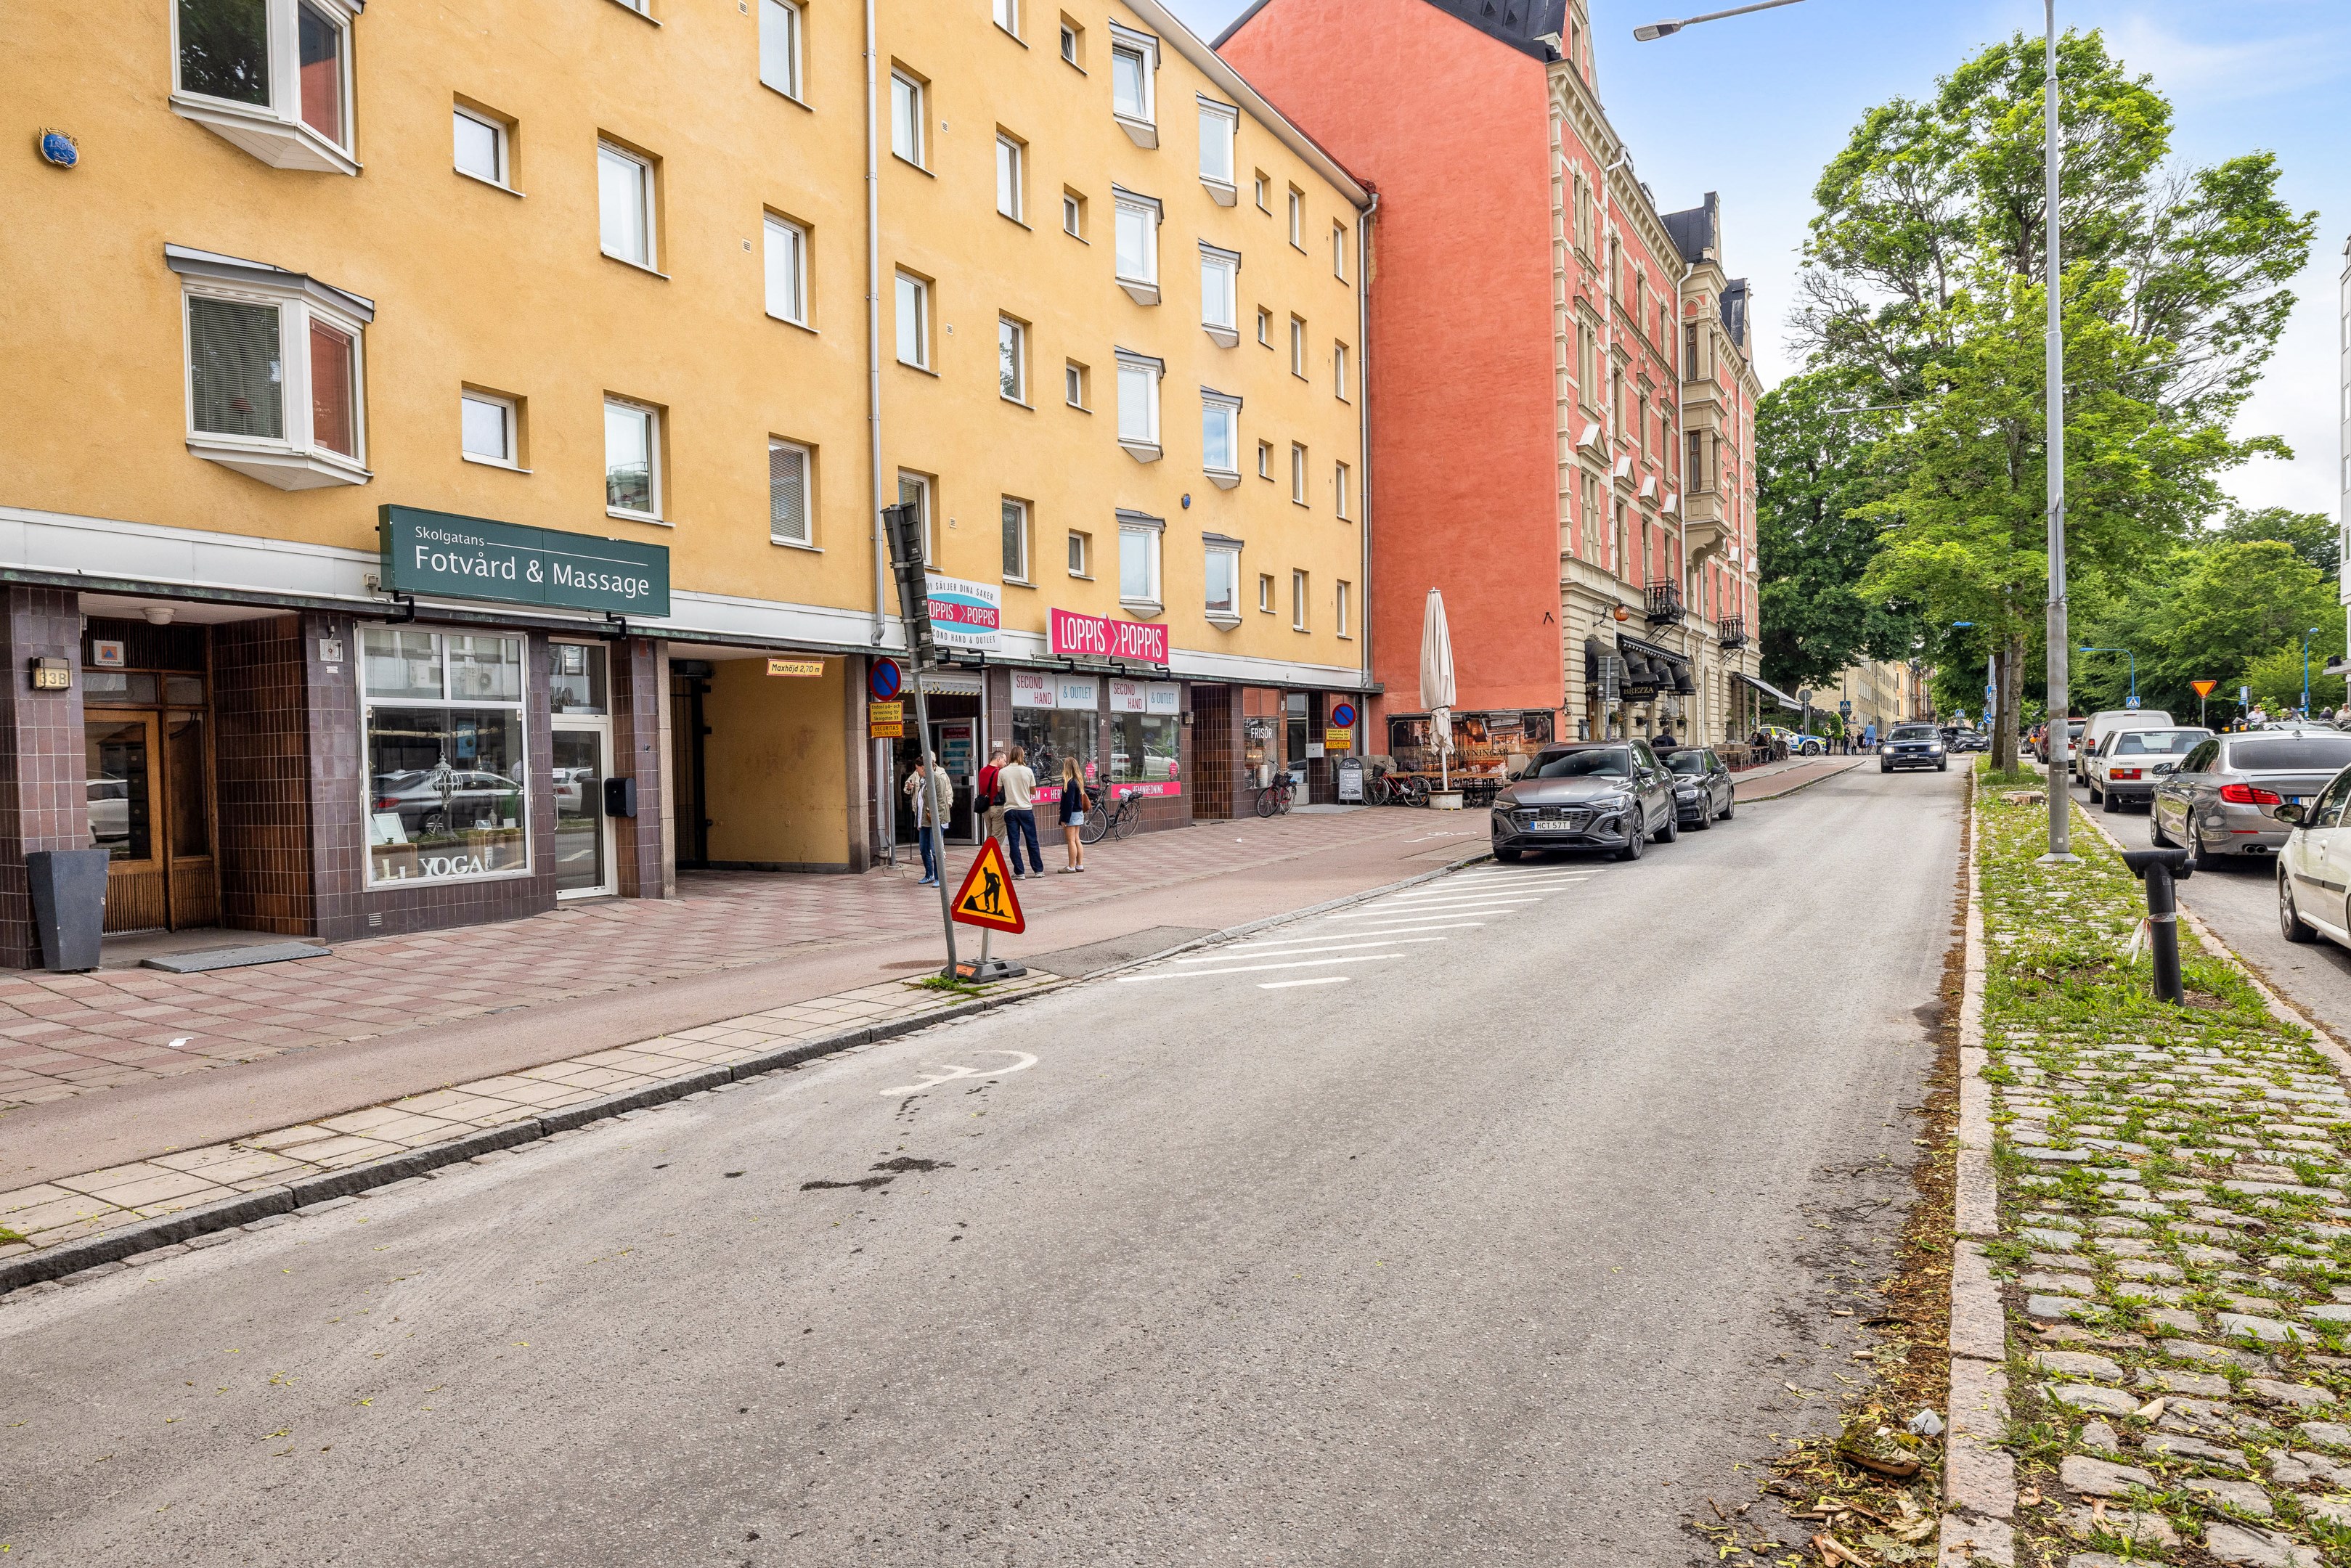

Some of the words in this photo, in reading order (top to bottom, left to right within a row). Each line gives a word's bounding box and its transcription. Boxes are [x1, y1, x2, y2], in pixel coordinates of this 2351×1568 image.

[415, 526, 484, 546] Skolgatans
[415, 545, 516, 580] Fotvård
[526, 560, 544, 583] &
[553, 563, 649, 599] Massage
[935, 581, 957, 591] SÄLJER
[960, 584, 974, 595] DINA
[976, 589, 993, 601] SAKER
[929, 601, 953, 620] OPPIS
[967, 607, 995, 626] POPPIS
[932, 629, 948, 640] COND
[951, 634, 966, 643] HAND
[1061, 616, 1106, 653] LOPPIS
[1120, 624, 1162, 658] POPPIS
[772, 664, 799, 673] Maxhöjd
[40, 672, 67, 685] 33B
[1016, 675, 1043, 690] SECOND
[1063, 686, 1068, 698] &
[1069, 686, 1091, 699] OUTLET
[1113, 682, 1136, 695] SECOND
[1034, 692, 1052, 705] HAND
[1128, 698, 1142, 709] HAND
[1151, 693, 1155, 703] &
[1157, 693, 1175, 704] OUTLET
[418, 855, 485, 877] YOGA
